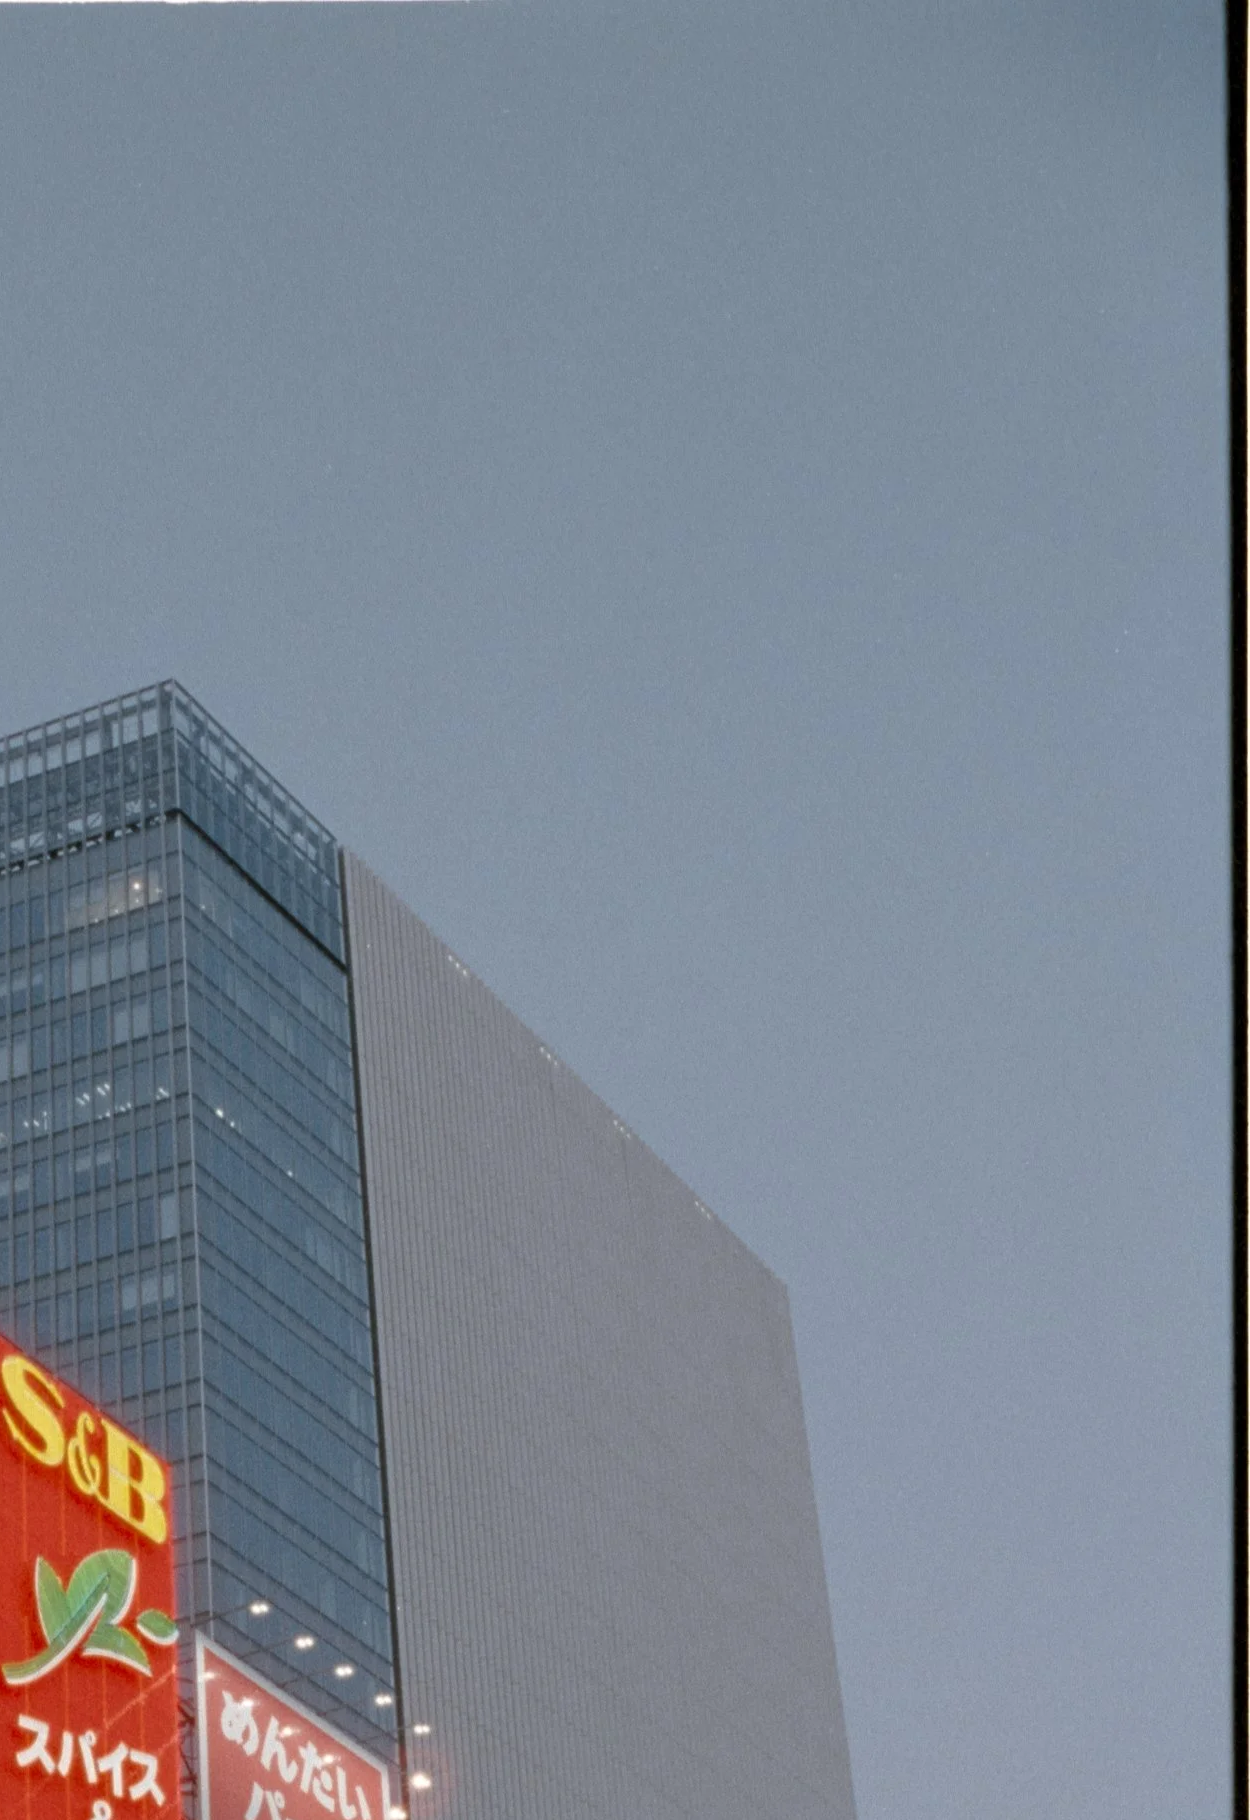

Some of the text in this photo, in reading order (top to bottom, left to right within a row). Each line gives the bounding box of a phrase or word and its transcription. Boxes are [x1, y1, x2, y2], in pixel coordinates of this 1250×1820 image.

[1, 1351, 168, 1544] S&B
[15, 1715, 165, 1805] スパイス
